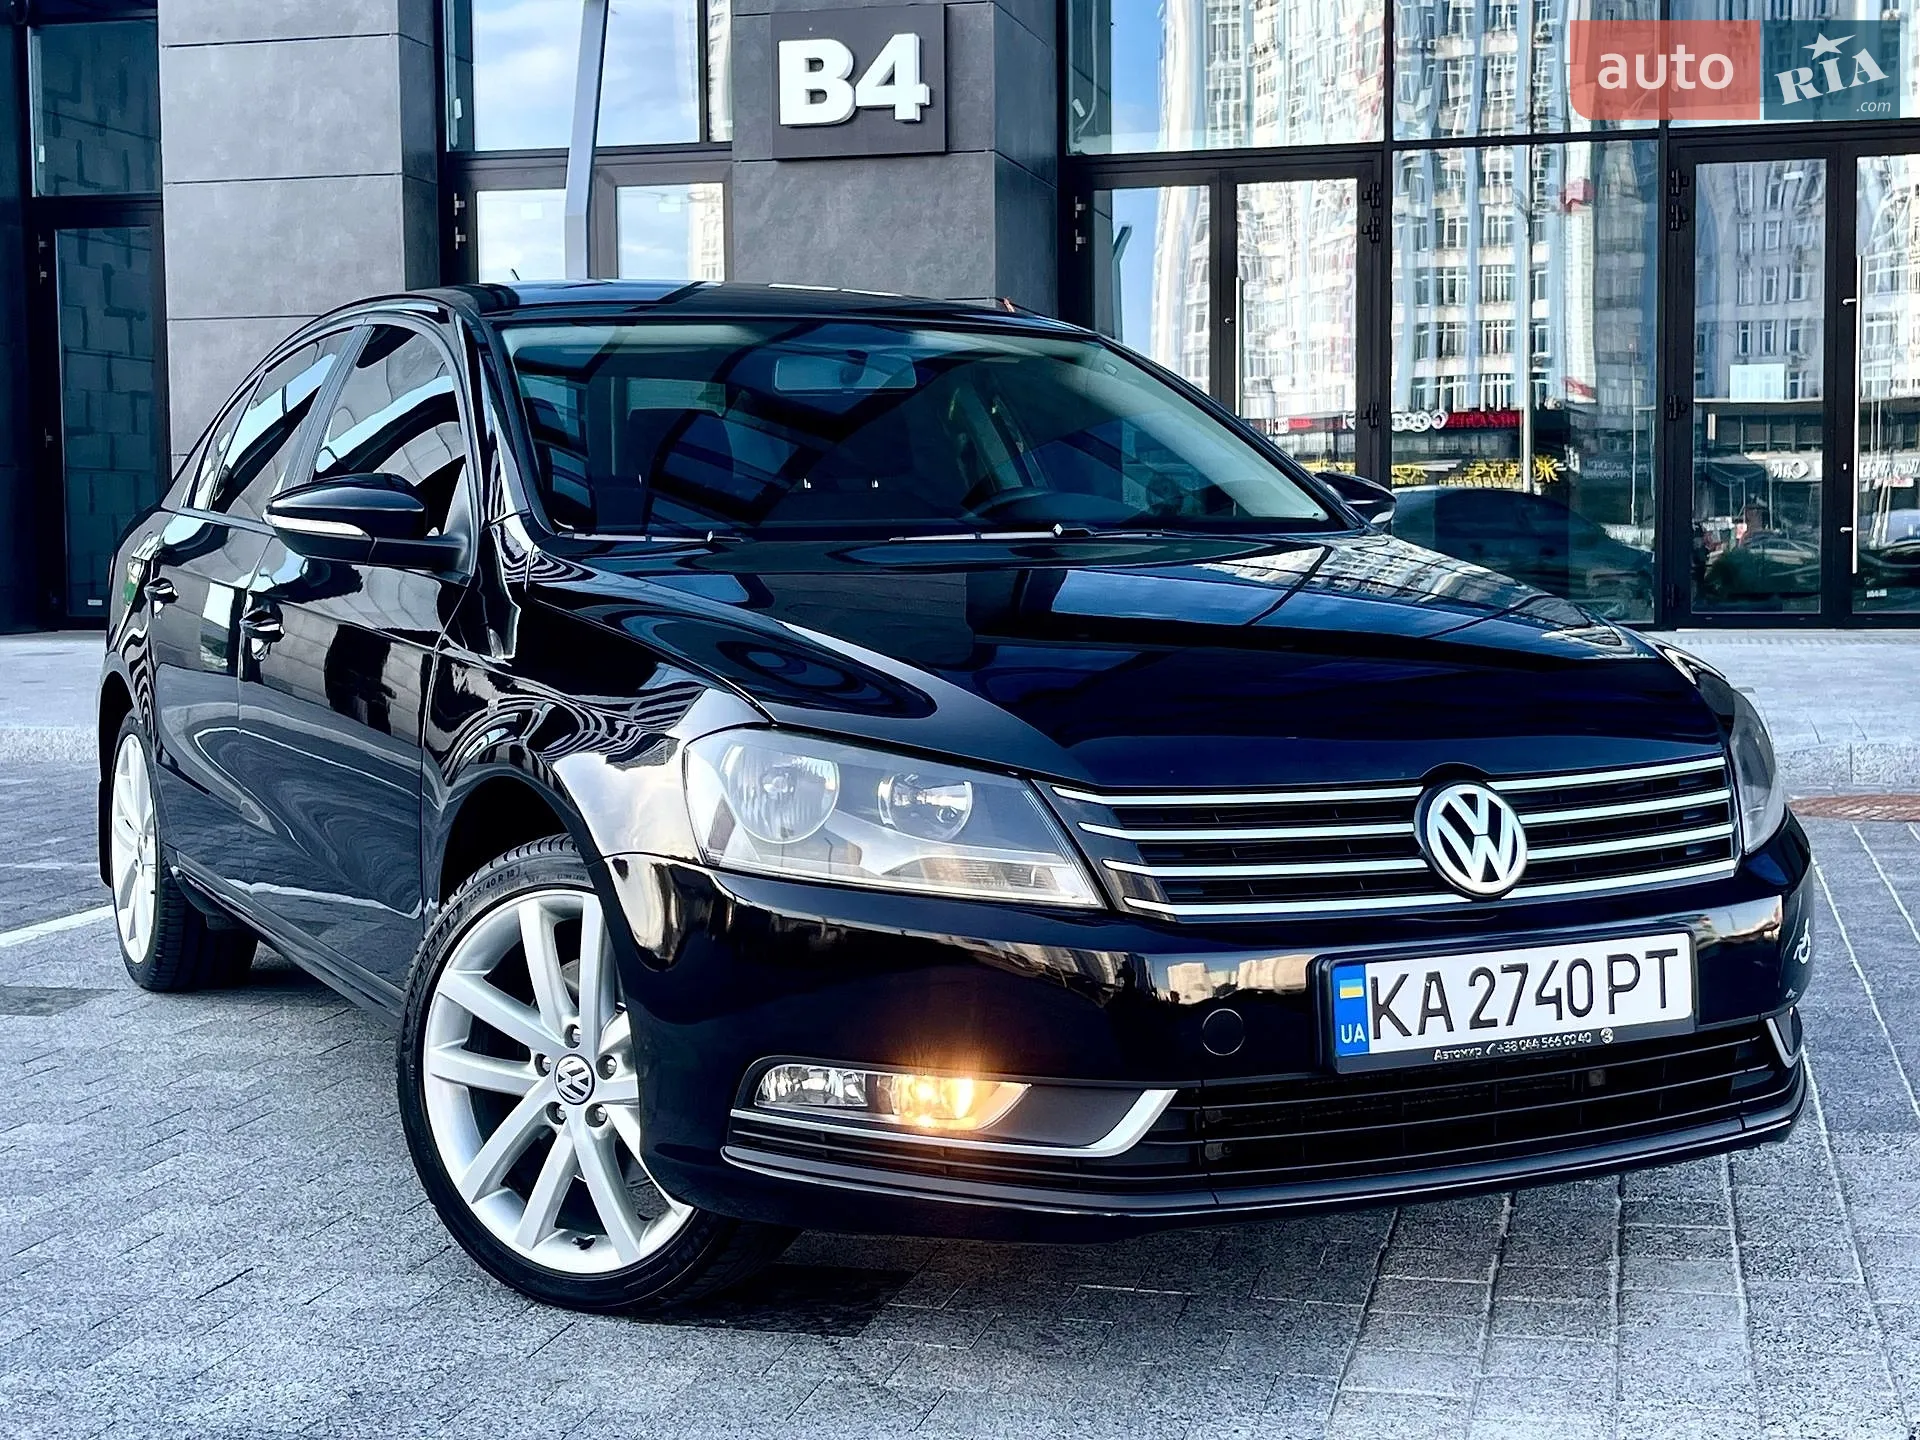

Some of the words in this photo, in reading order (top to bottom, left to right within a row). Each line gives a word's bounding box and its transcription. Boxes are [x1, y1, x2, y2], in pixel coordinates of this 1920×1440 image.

[778, 33, 931, 125] B4
[1371, 970, 1454, 1040] KA
[1468, 958, 1592, 1030] 2740
[1608, 948, 1678, 1015] PT
[1341, 1023, 1366, 1044] UA
[1578, 1031, 1592, 1043] 40
